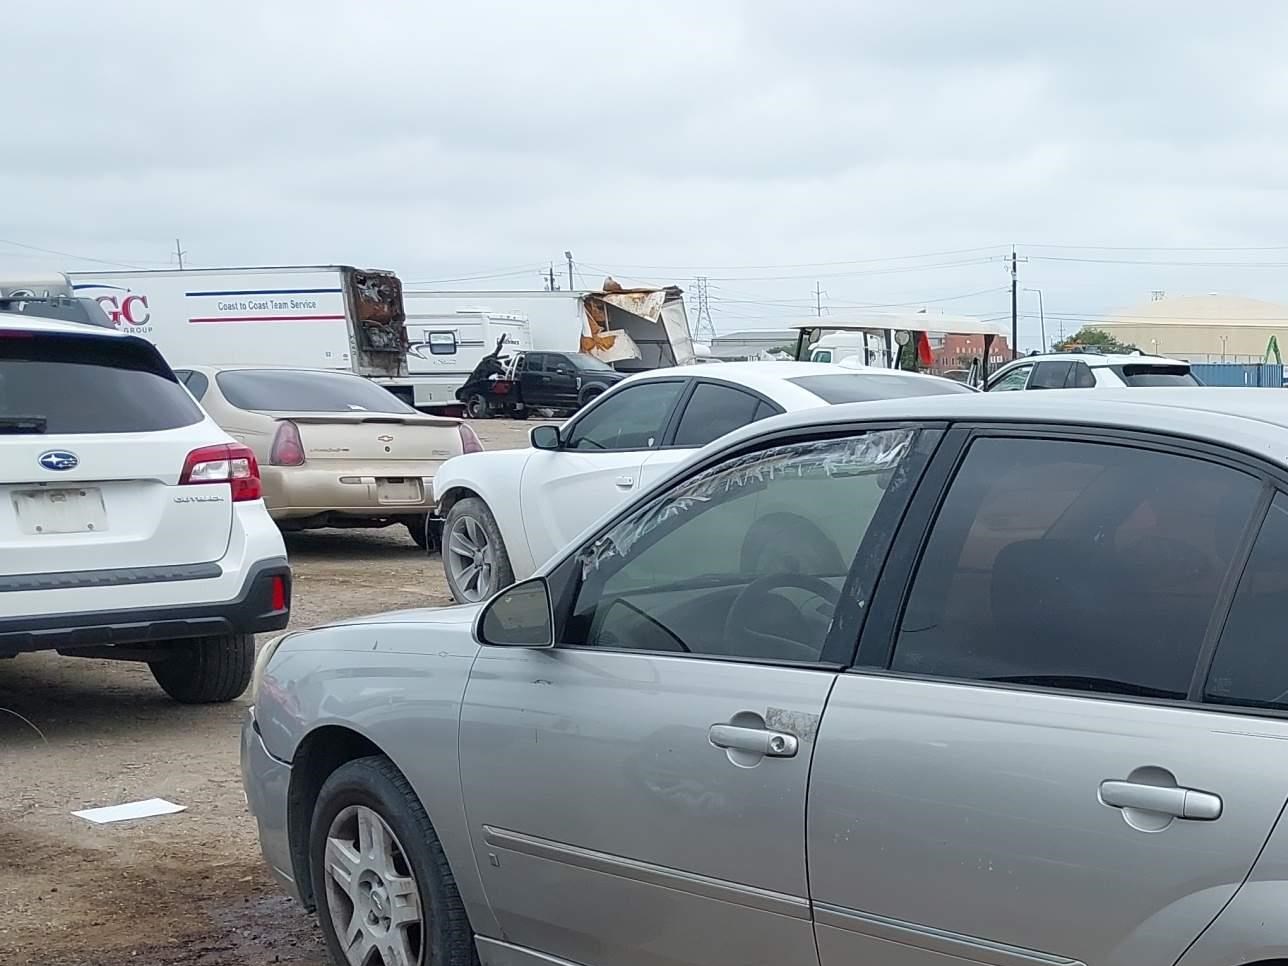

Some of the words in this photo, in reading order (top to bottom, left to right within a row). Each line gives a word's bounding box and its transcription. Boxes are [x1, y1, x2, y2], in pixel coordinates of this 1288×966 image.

[217, 301, 238, 311] Coast
[239, 301, 247, 310] to
[248, 300, 269, 310] Coast
[270, 300, 289, 309] Team
[290, 299, 317, 309] Service
